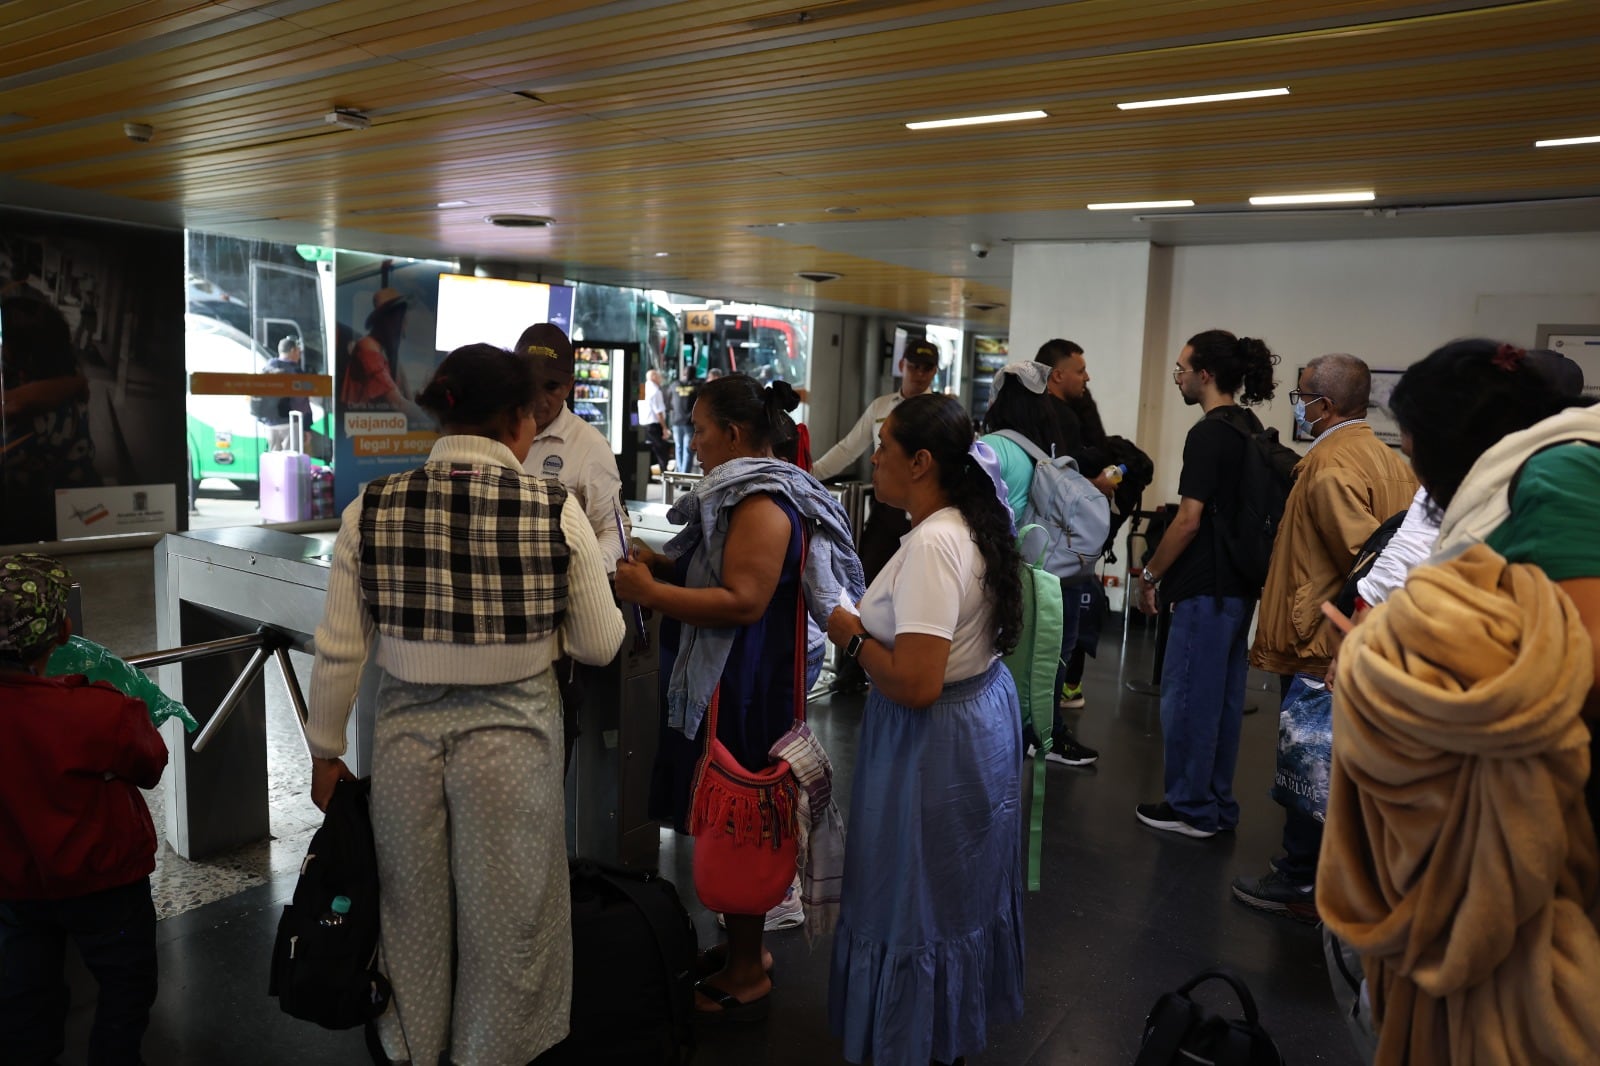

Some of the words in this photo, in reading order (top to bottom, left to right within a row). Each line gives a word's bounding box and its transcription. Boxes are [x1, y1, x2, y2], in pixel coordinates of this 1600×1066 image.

[691, 315, 709, 326] 46
[348, 415, 404, 431] viajando
[360, 438, 390, 452] legal
[393, 440, 401, 452] y
